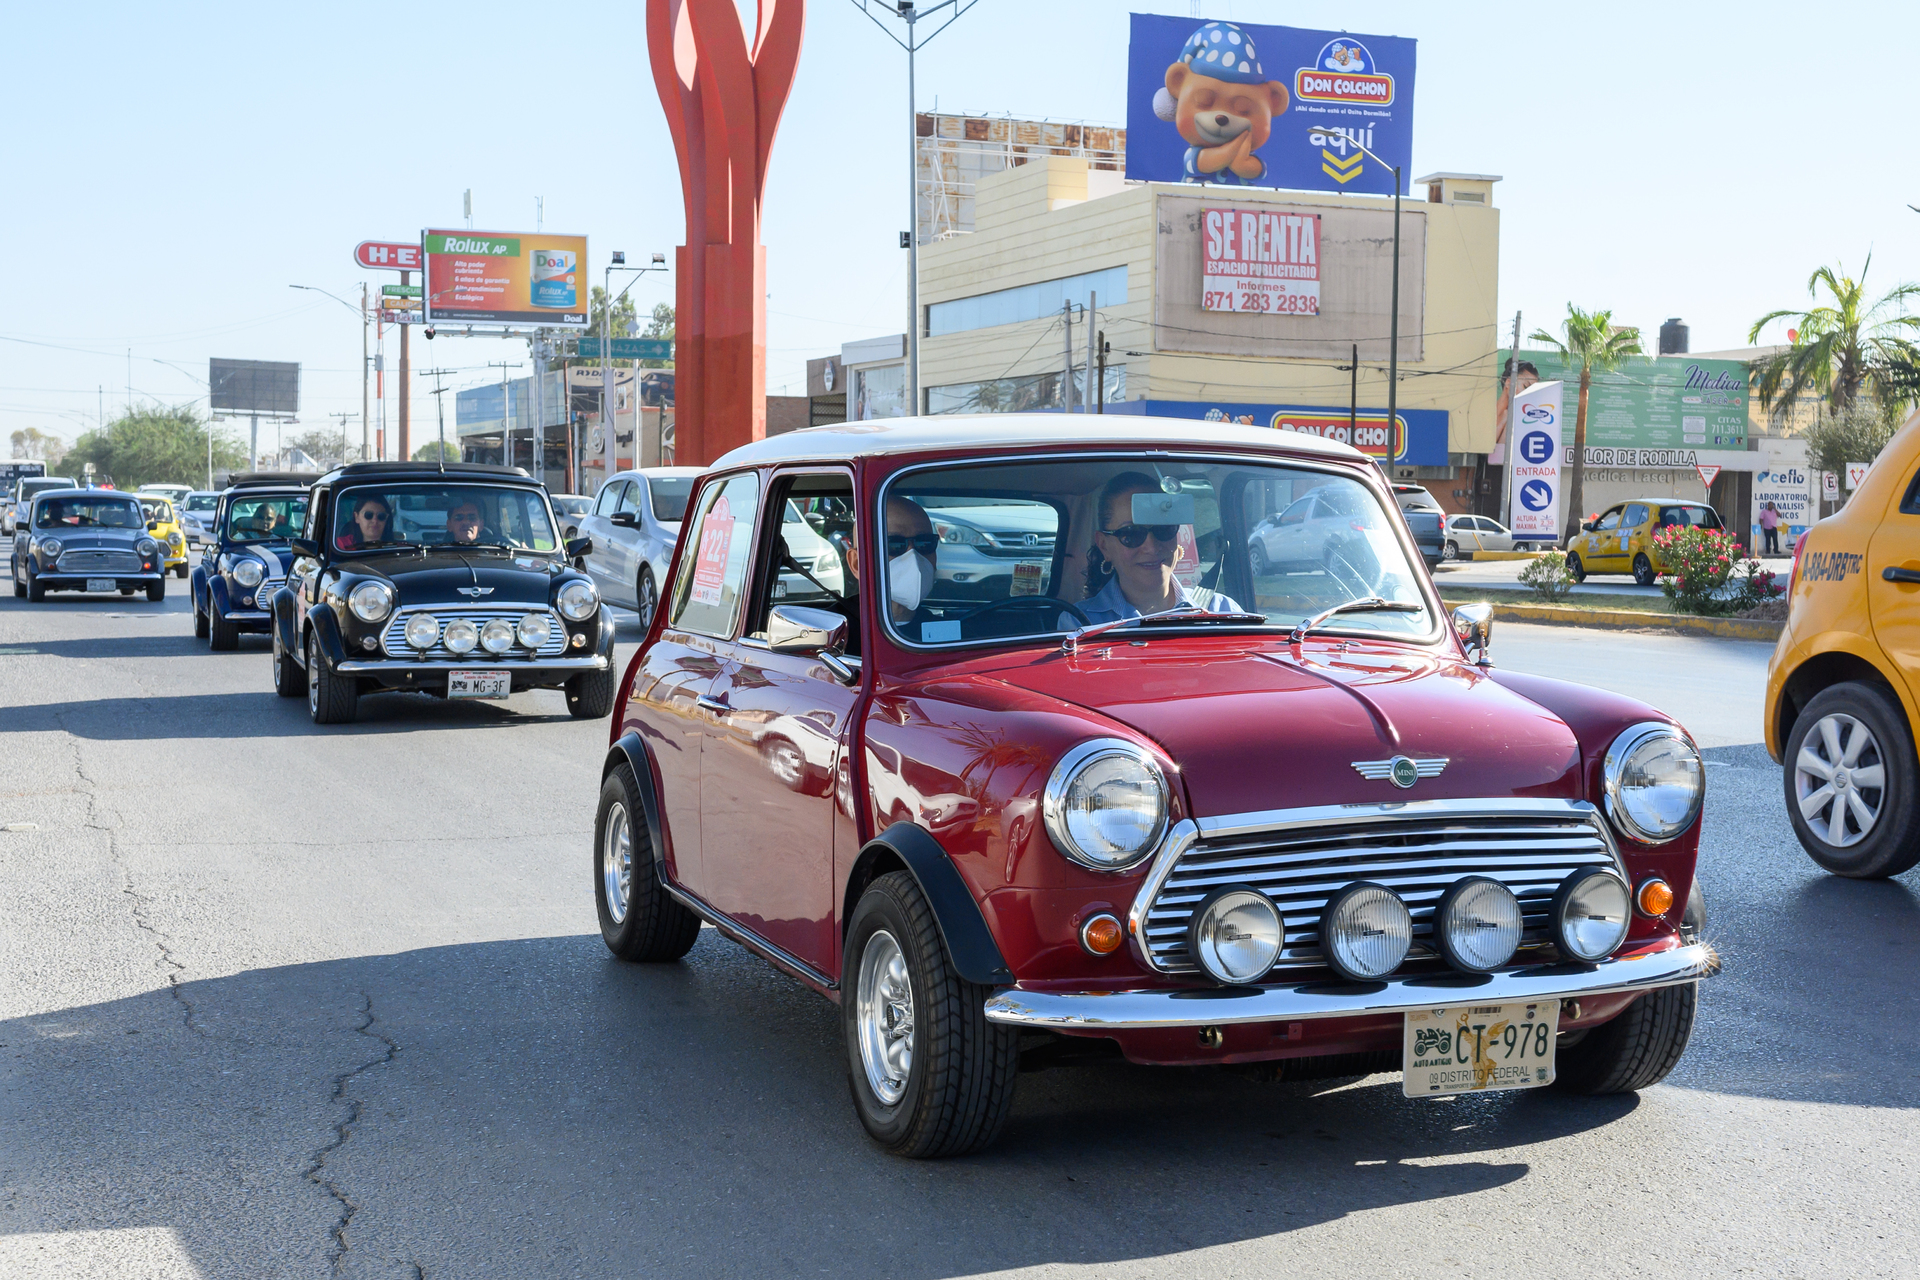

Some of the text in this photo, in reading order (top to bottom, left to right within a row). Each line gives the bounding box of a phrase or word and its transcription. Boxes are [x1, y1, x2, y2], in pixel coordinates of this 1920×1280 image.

[1303, 76, 1387, 97] DON COLCHON
[1309, 122, 1376, 156] aquí
[1206, 211, 1316, 264] SE RENTA
[444, 237, 490, 254] Rolux
[536, 254, 568, 268] Doal
[1207, 260, 1317, 279] ESPACIO PUBLICITARIO
[386, 286, 421, 294] FRESCUR
[539, 286, 562, 296] Rolux
[1236, 280, 1286, 292] Informes
[1204, 291, 1317, 313] 871 283 2838
[563, 314, 583, 323] Doal
[1684, 364, 1744, 393] Medica
[1701, 396, 1729, 406] LASER
[1717, 416, 1742, 425] CITAS
[1711, 424, 1744, 435] 711.3611
[1528, 436, 1545, 458] E
[1565, 448, 1698, 467] DLOR DE RODILLA
[1516, 467, 1557, 476] ENTRADA
[1633, 470, 1673, 484] Laser
[1770, 468, 1805, 484] ceflo
[1754, 492, 1808, 501] LABORATORIO
[1847, 554, 1863, 574] TRC
[472, 680, 506, 693] MG-3F
[1397, 769, 1414, 777] MINI
[1455, 1021, 1550, 1065] CT-978
[1412, 1057, 1452, 1068] AUTO ANTIGUO
[1429, 1066, 1531, 1084] 09 DISTRITO FEDERAL
